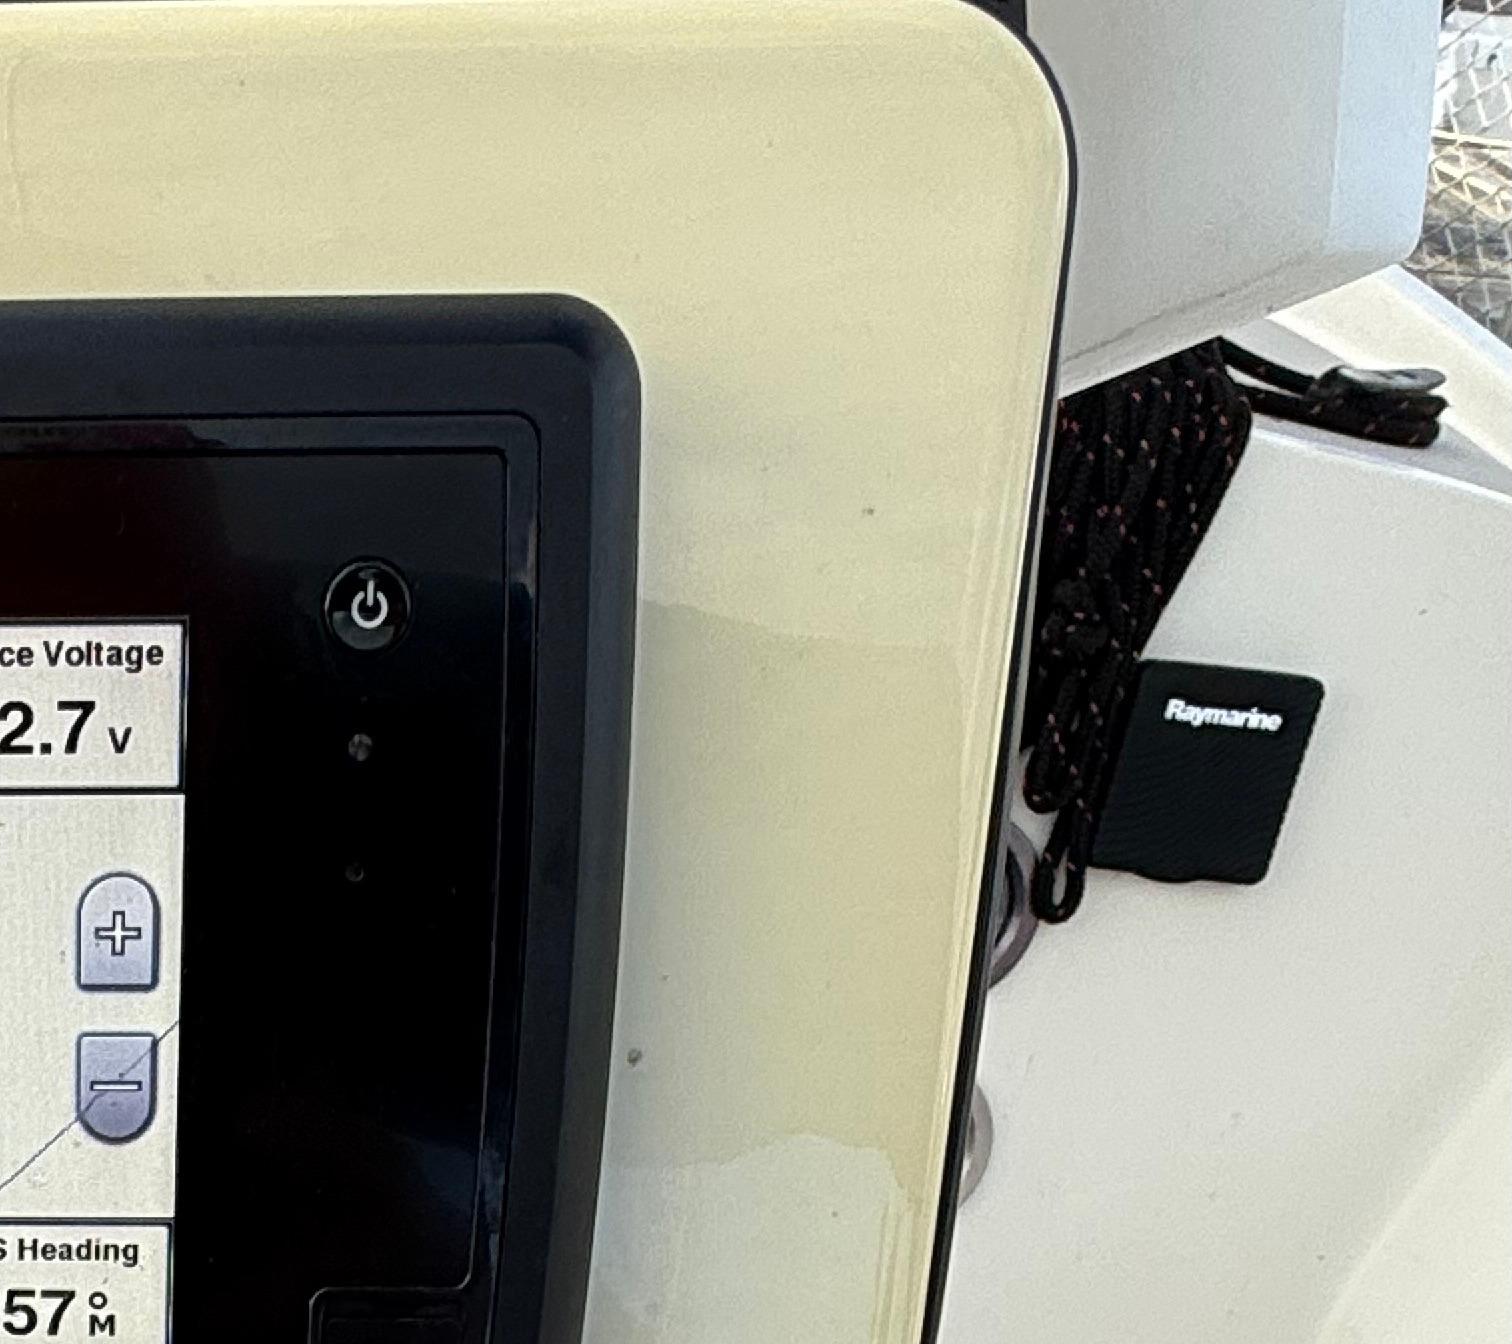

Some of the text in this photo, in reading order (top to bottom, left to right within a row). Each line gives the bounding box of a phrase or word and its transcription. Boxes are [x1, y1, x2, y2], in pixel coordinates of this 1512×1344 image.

[43, 642, 164, 674] Voltage
[1164, 699, 1284, 731] Raymarine
[18, 1238, 139, 1268] Heading
